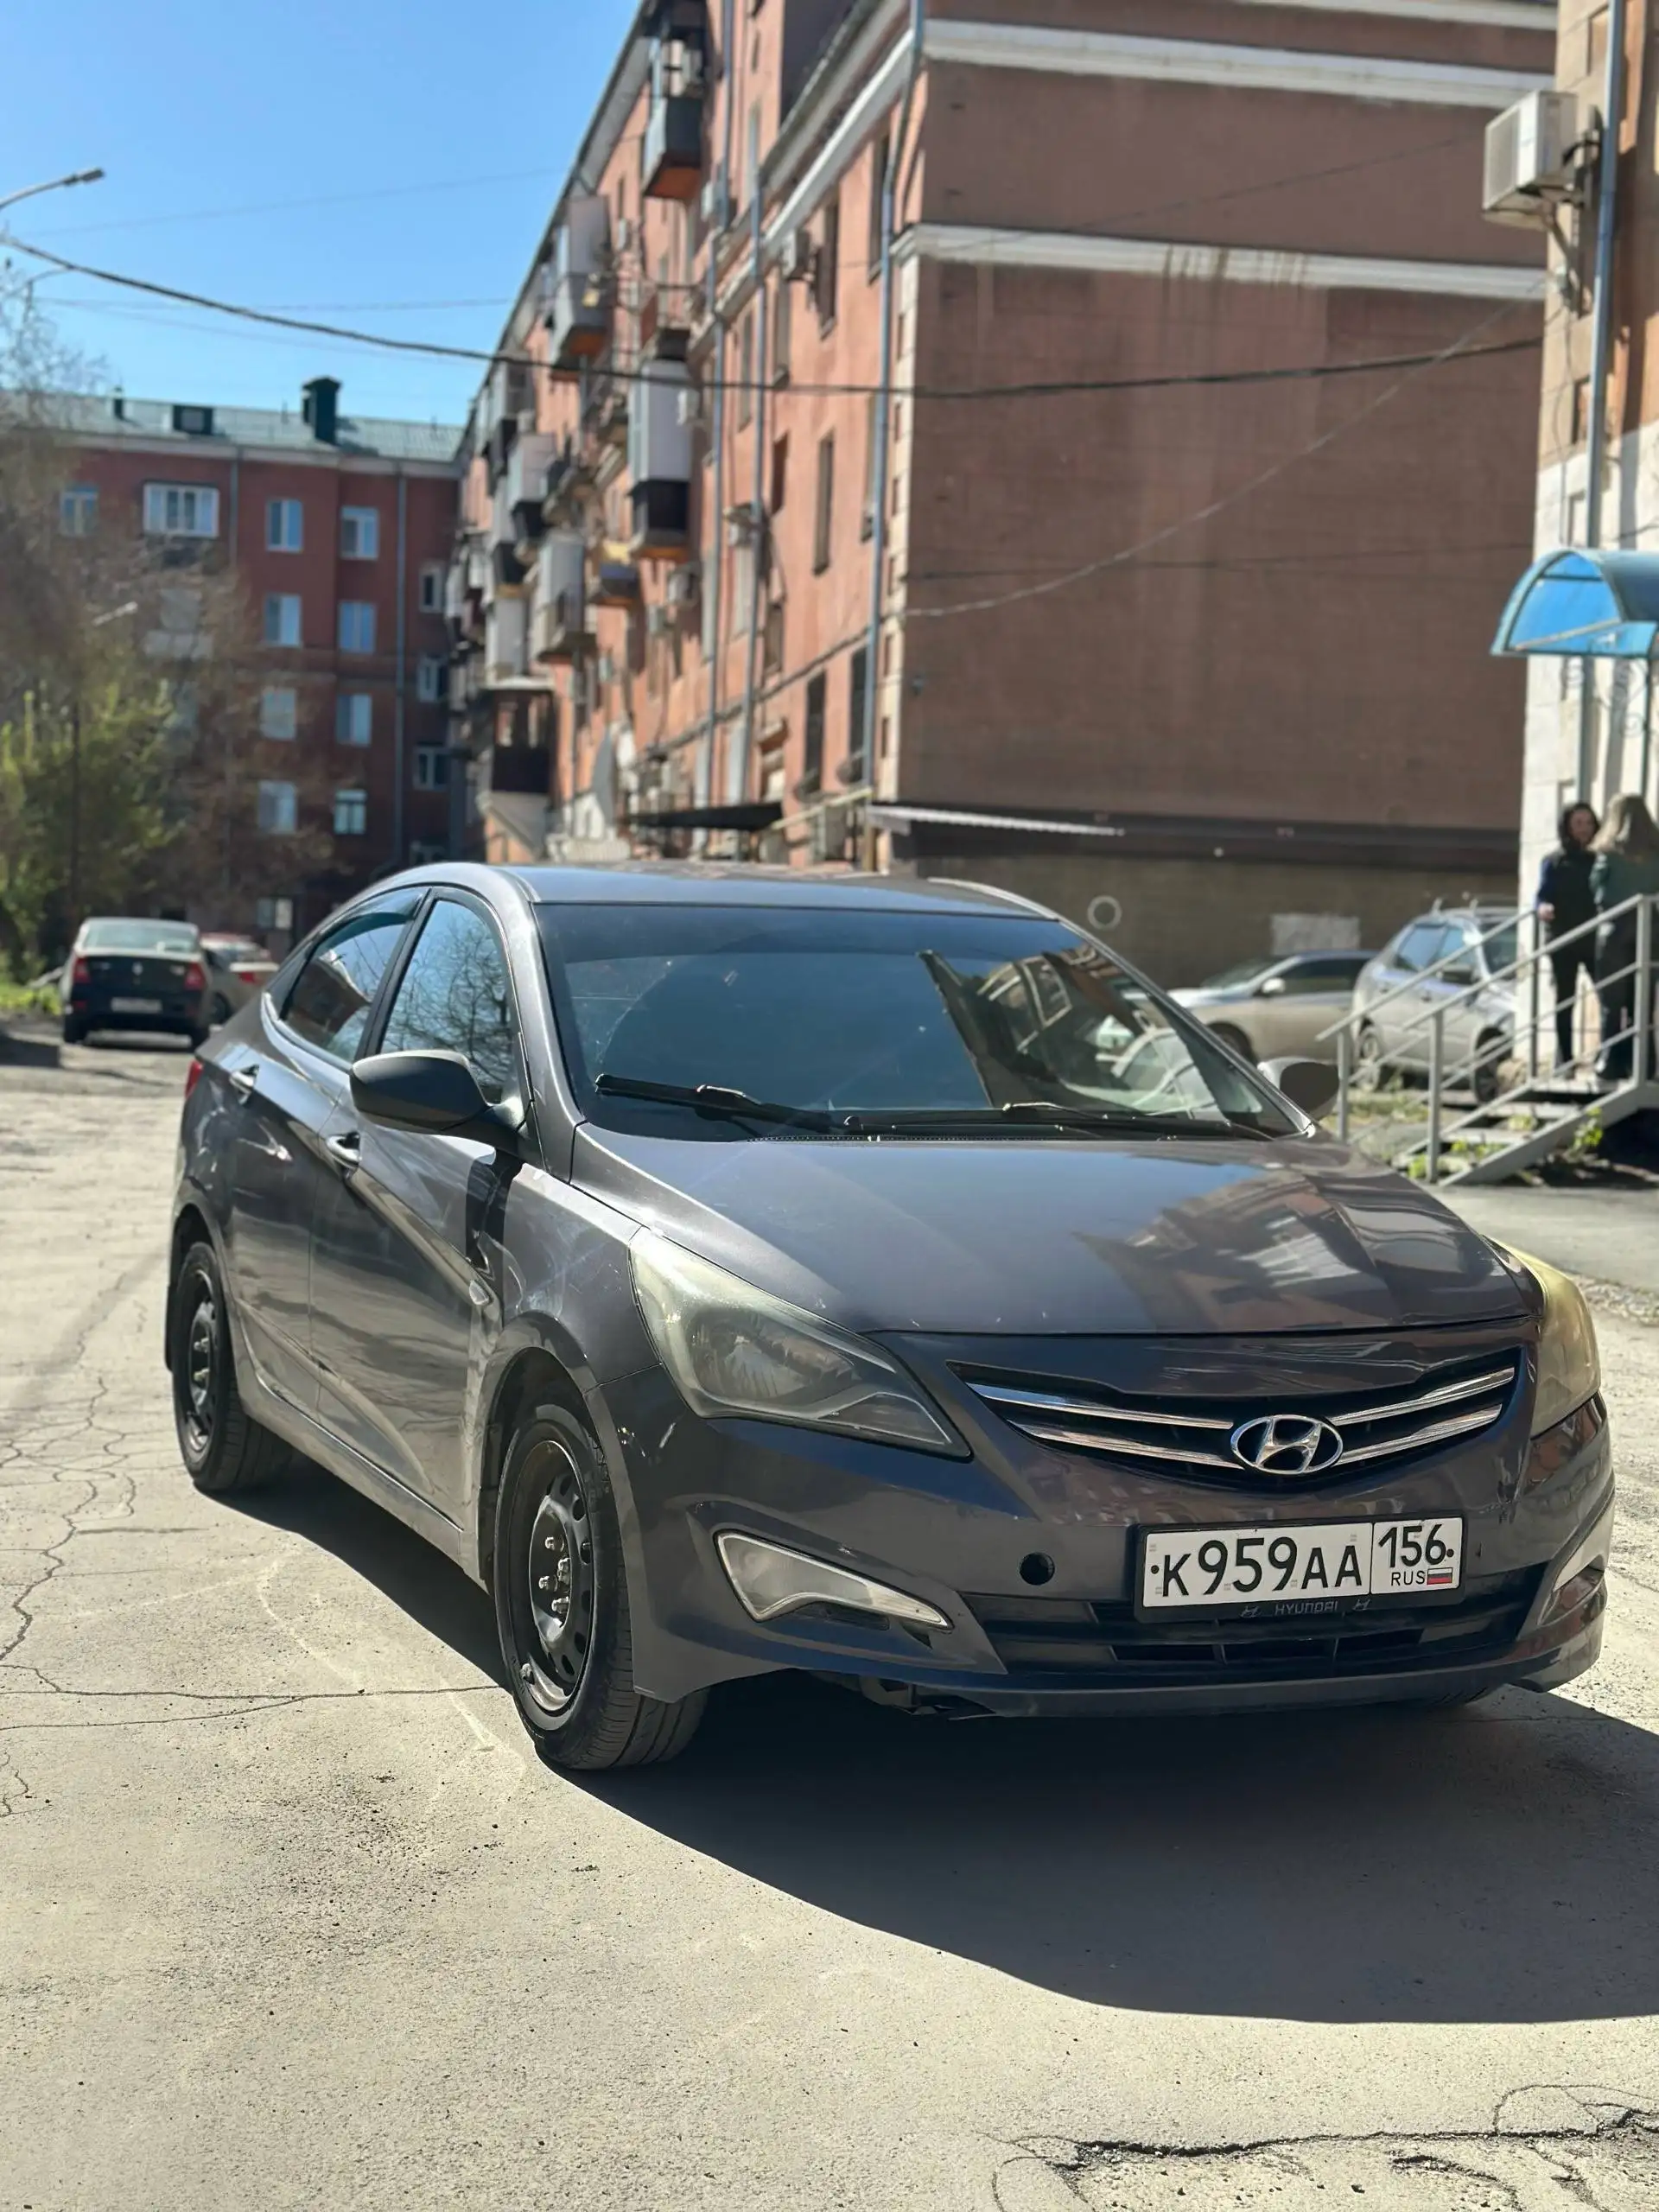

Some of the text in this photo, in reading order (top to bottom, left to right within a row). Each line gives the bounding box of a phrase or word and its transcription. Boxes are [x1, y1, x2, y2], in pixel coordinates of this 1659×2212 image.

[1378, 1523, 1446, 1567] 156
[1391, 1570, 1425, 1586] RUS
[1274, 1600, 1338, 1617] HYUNDAI
